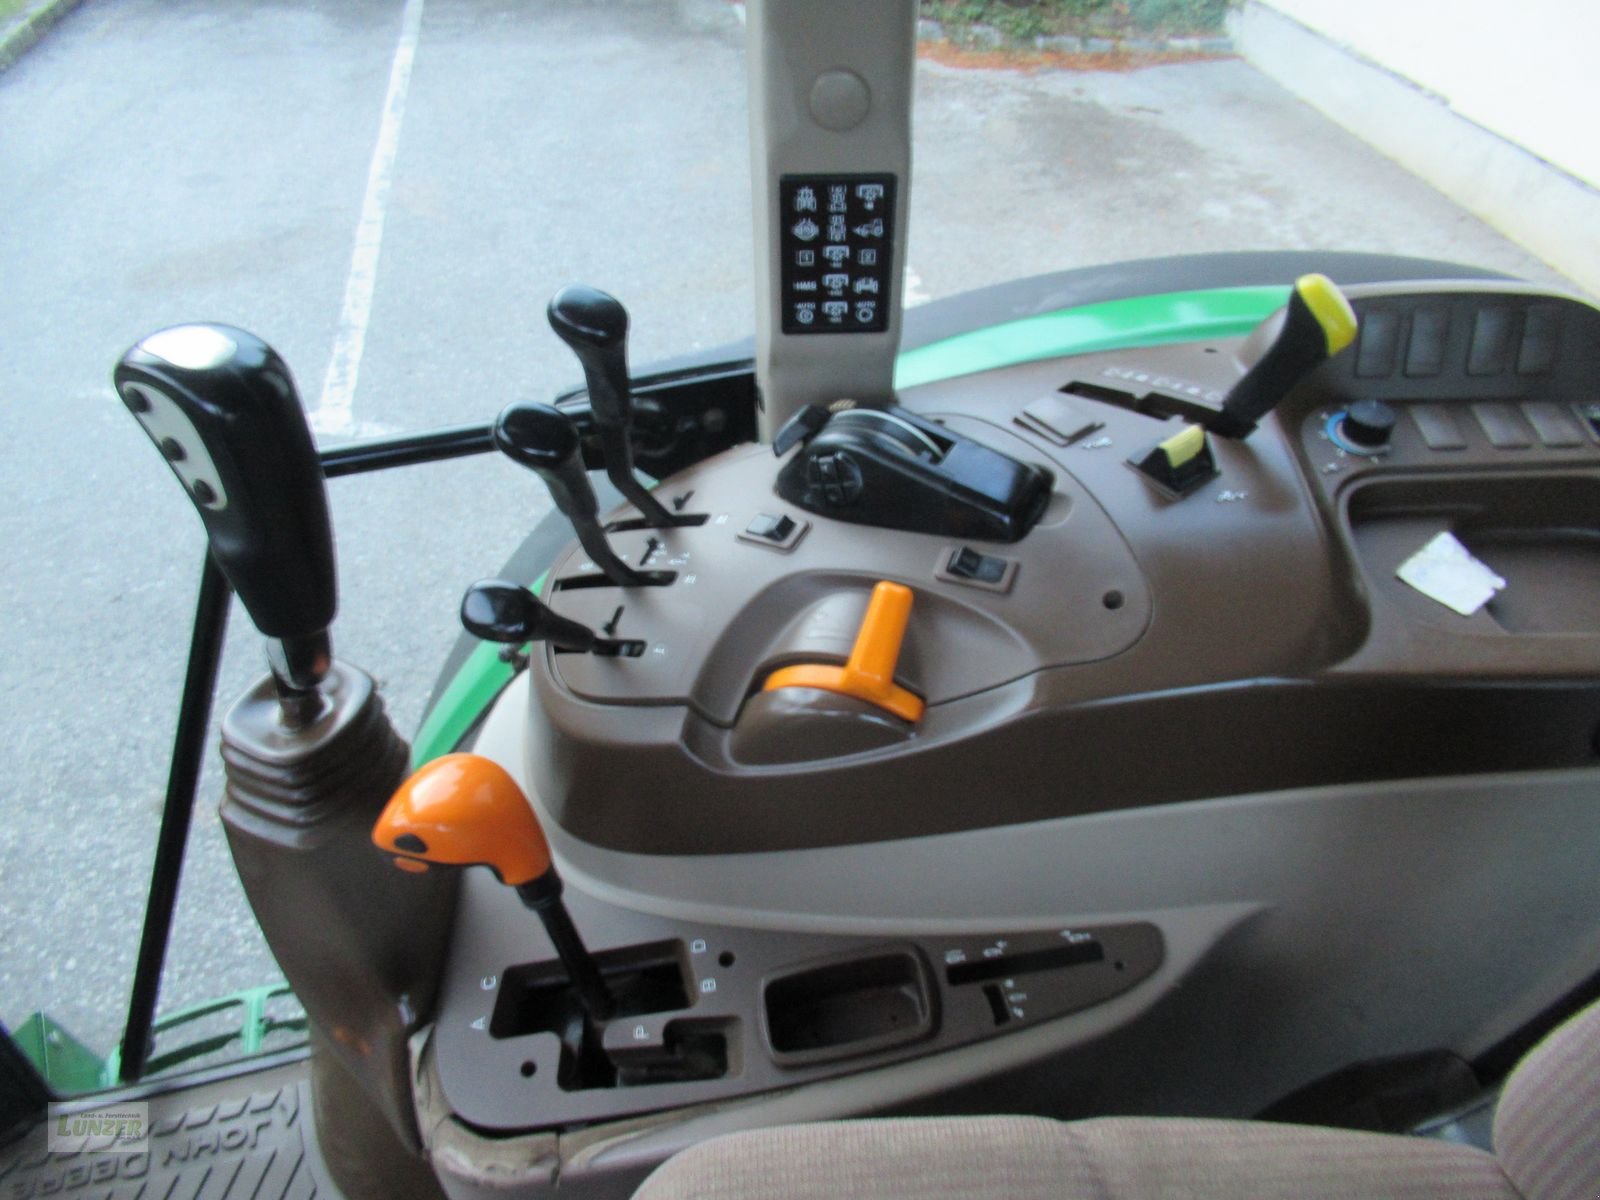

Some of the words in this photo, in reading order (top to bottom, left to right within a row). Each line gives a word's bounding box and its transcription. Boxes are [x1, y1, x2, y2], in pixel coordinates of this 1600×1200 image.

[691, 938, 707, 953] D
[481, 975, 496, 990] C
[702, 977, 717, 992] B
[470, 1016, 486, 1030] A
[163, 1120, 271, 1168] JOHN
